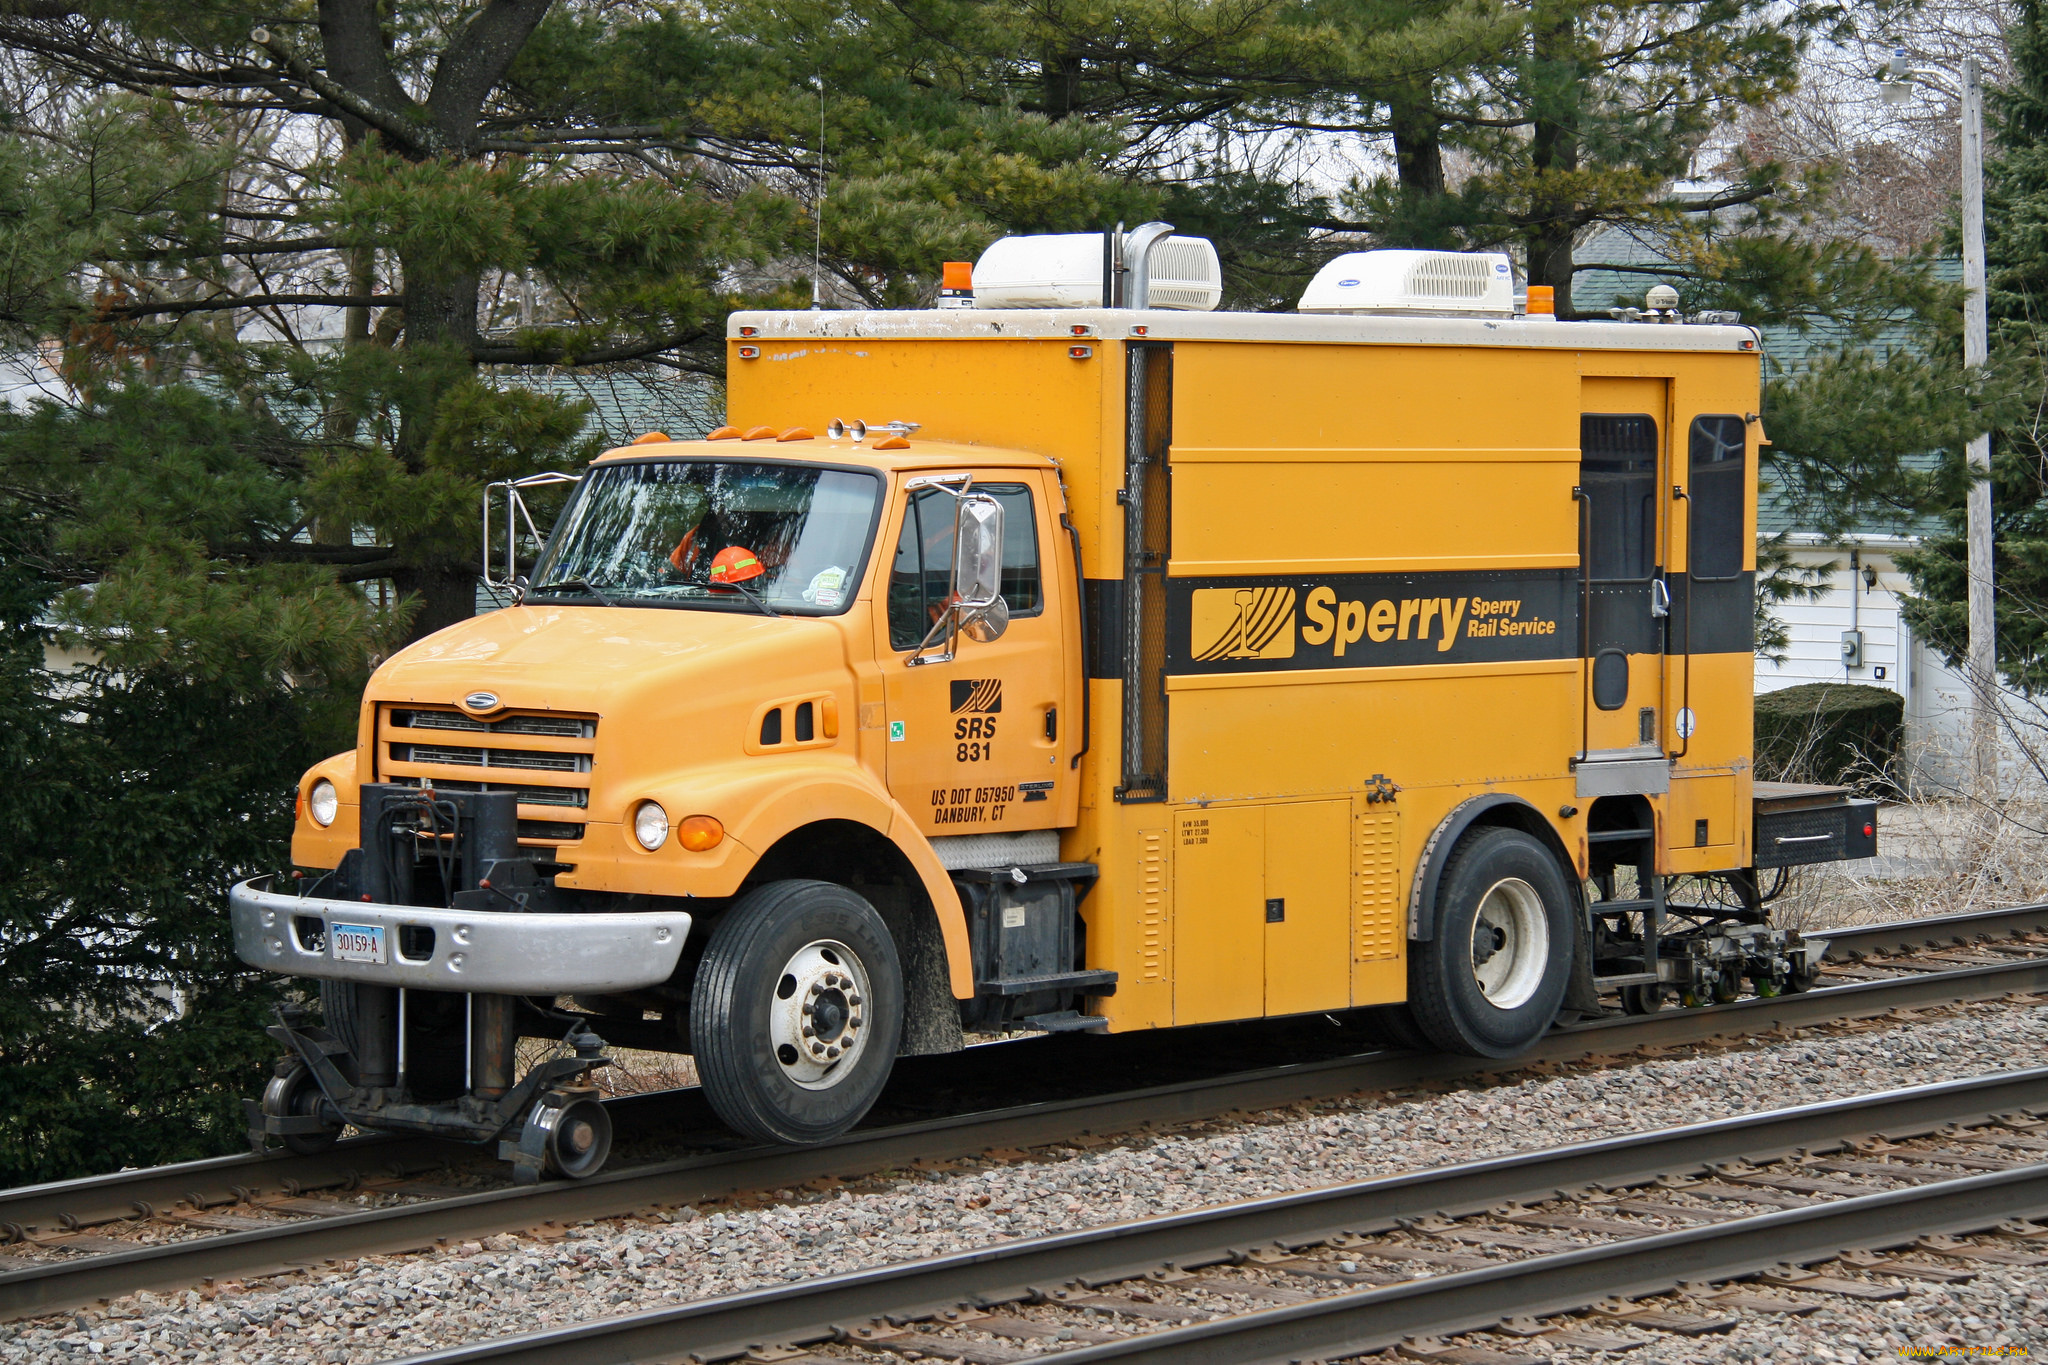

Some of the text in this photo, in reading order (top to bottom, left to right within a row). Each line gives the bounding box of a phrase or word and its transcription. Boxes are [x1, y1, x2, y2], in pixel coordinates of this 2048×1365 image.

[1470, 597, 1521, 618] Sperry
[1301, 586, 1468, 657] Sperry
[1467, 617, 1556, 638] Rail Service
[954, 716, 997, 740] SRS
[956, 742, 990, 762] 831
[931, 785, 1015, 806] US DOT 057950
[934, 805, 1006, 825] DANBURY, CT
